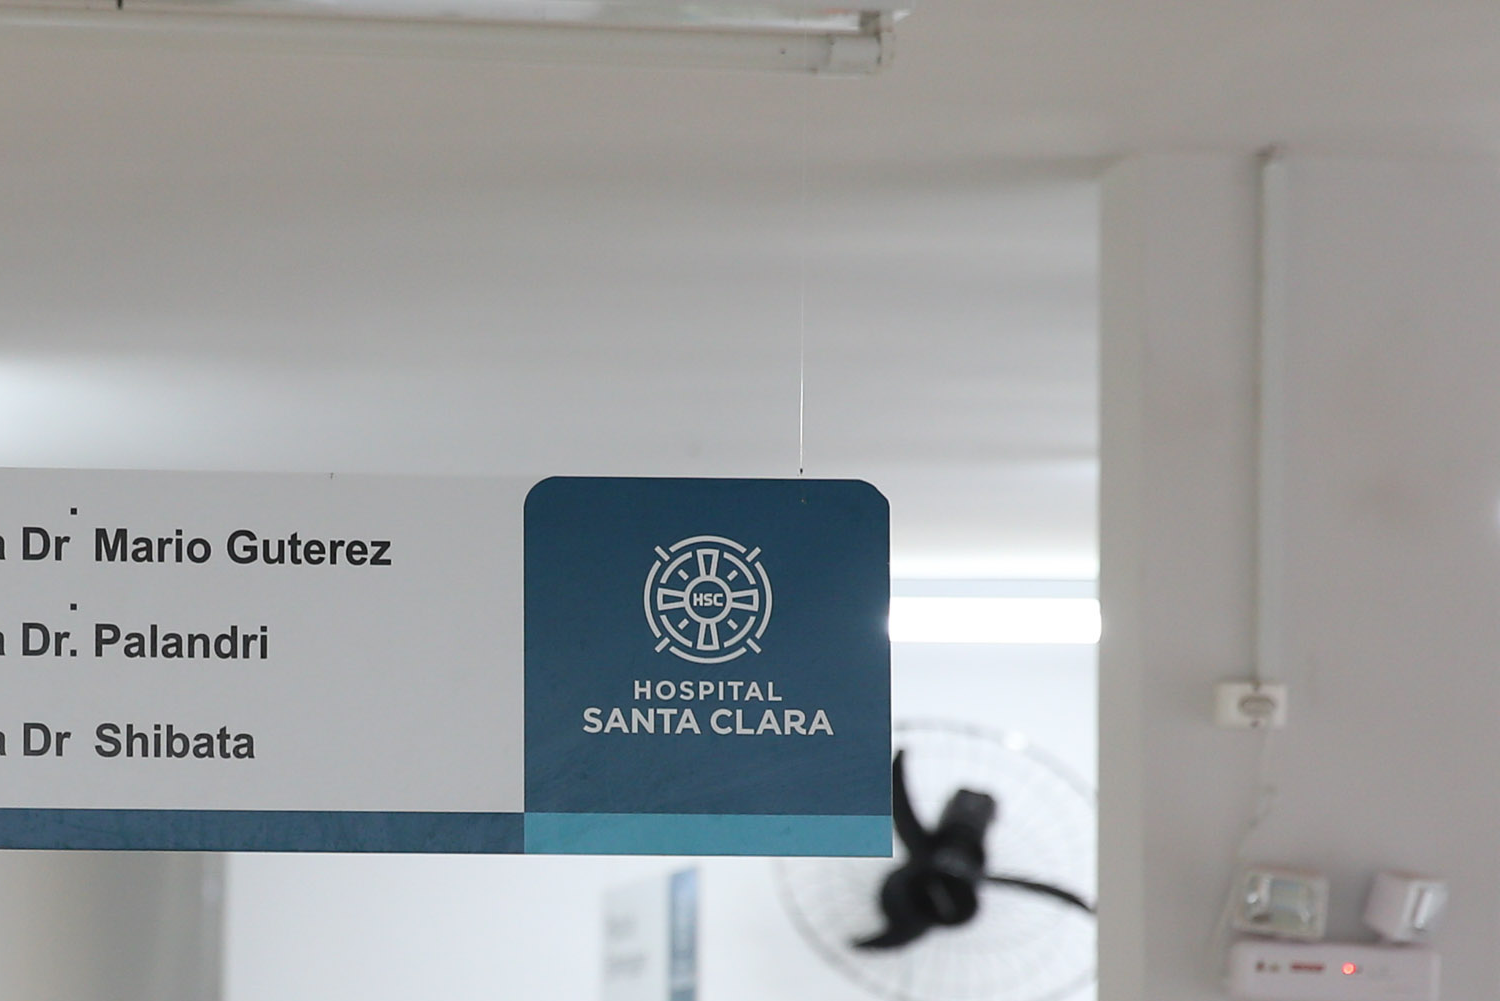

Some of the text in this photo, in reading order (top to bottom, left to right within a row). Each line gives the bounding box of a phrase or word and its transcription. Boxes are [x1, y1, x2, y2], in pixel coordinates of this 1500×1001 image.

[94, 527, 213, 564] Mario
[226, 529, 393, 567] Guterez
[693, 593, 724, 607] HSC
[21, 622, 78, 658] Dr.
[94, 623, 269, 660] Palandri
[633, 680, 783, 702] HOSPITAL
[583, 707, 834, 736] SANTA CLARA
[94, 722, 256, 760] Shibata
